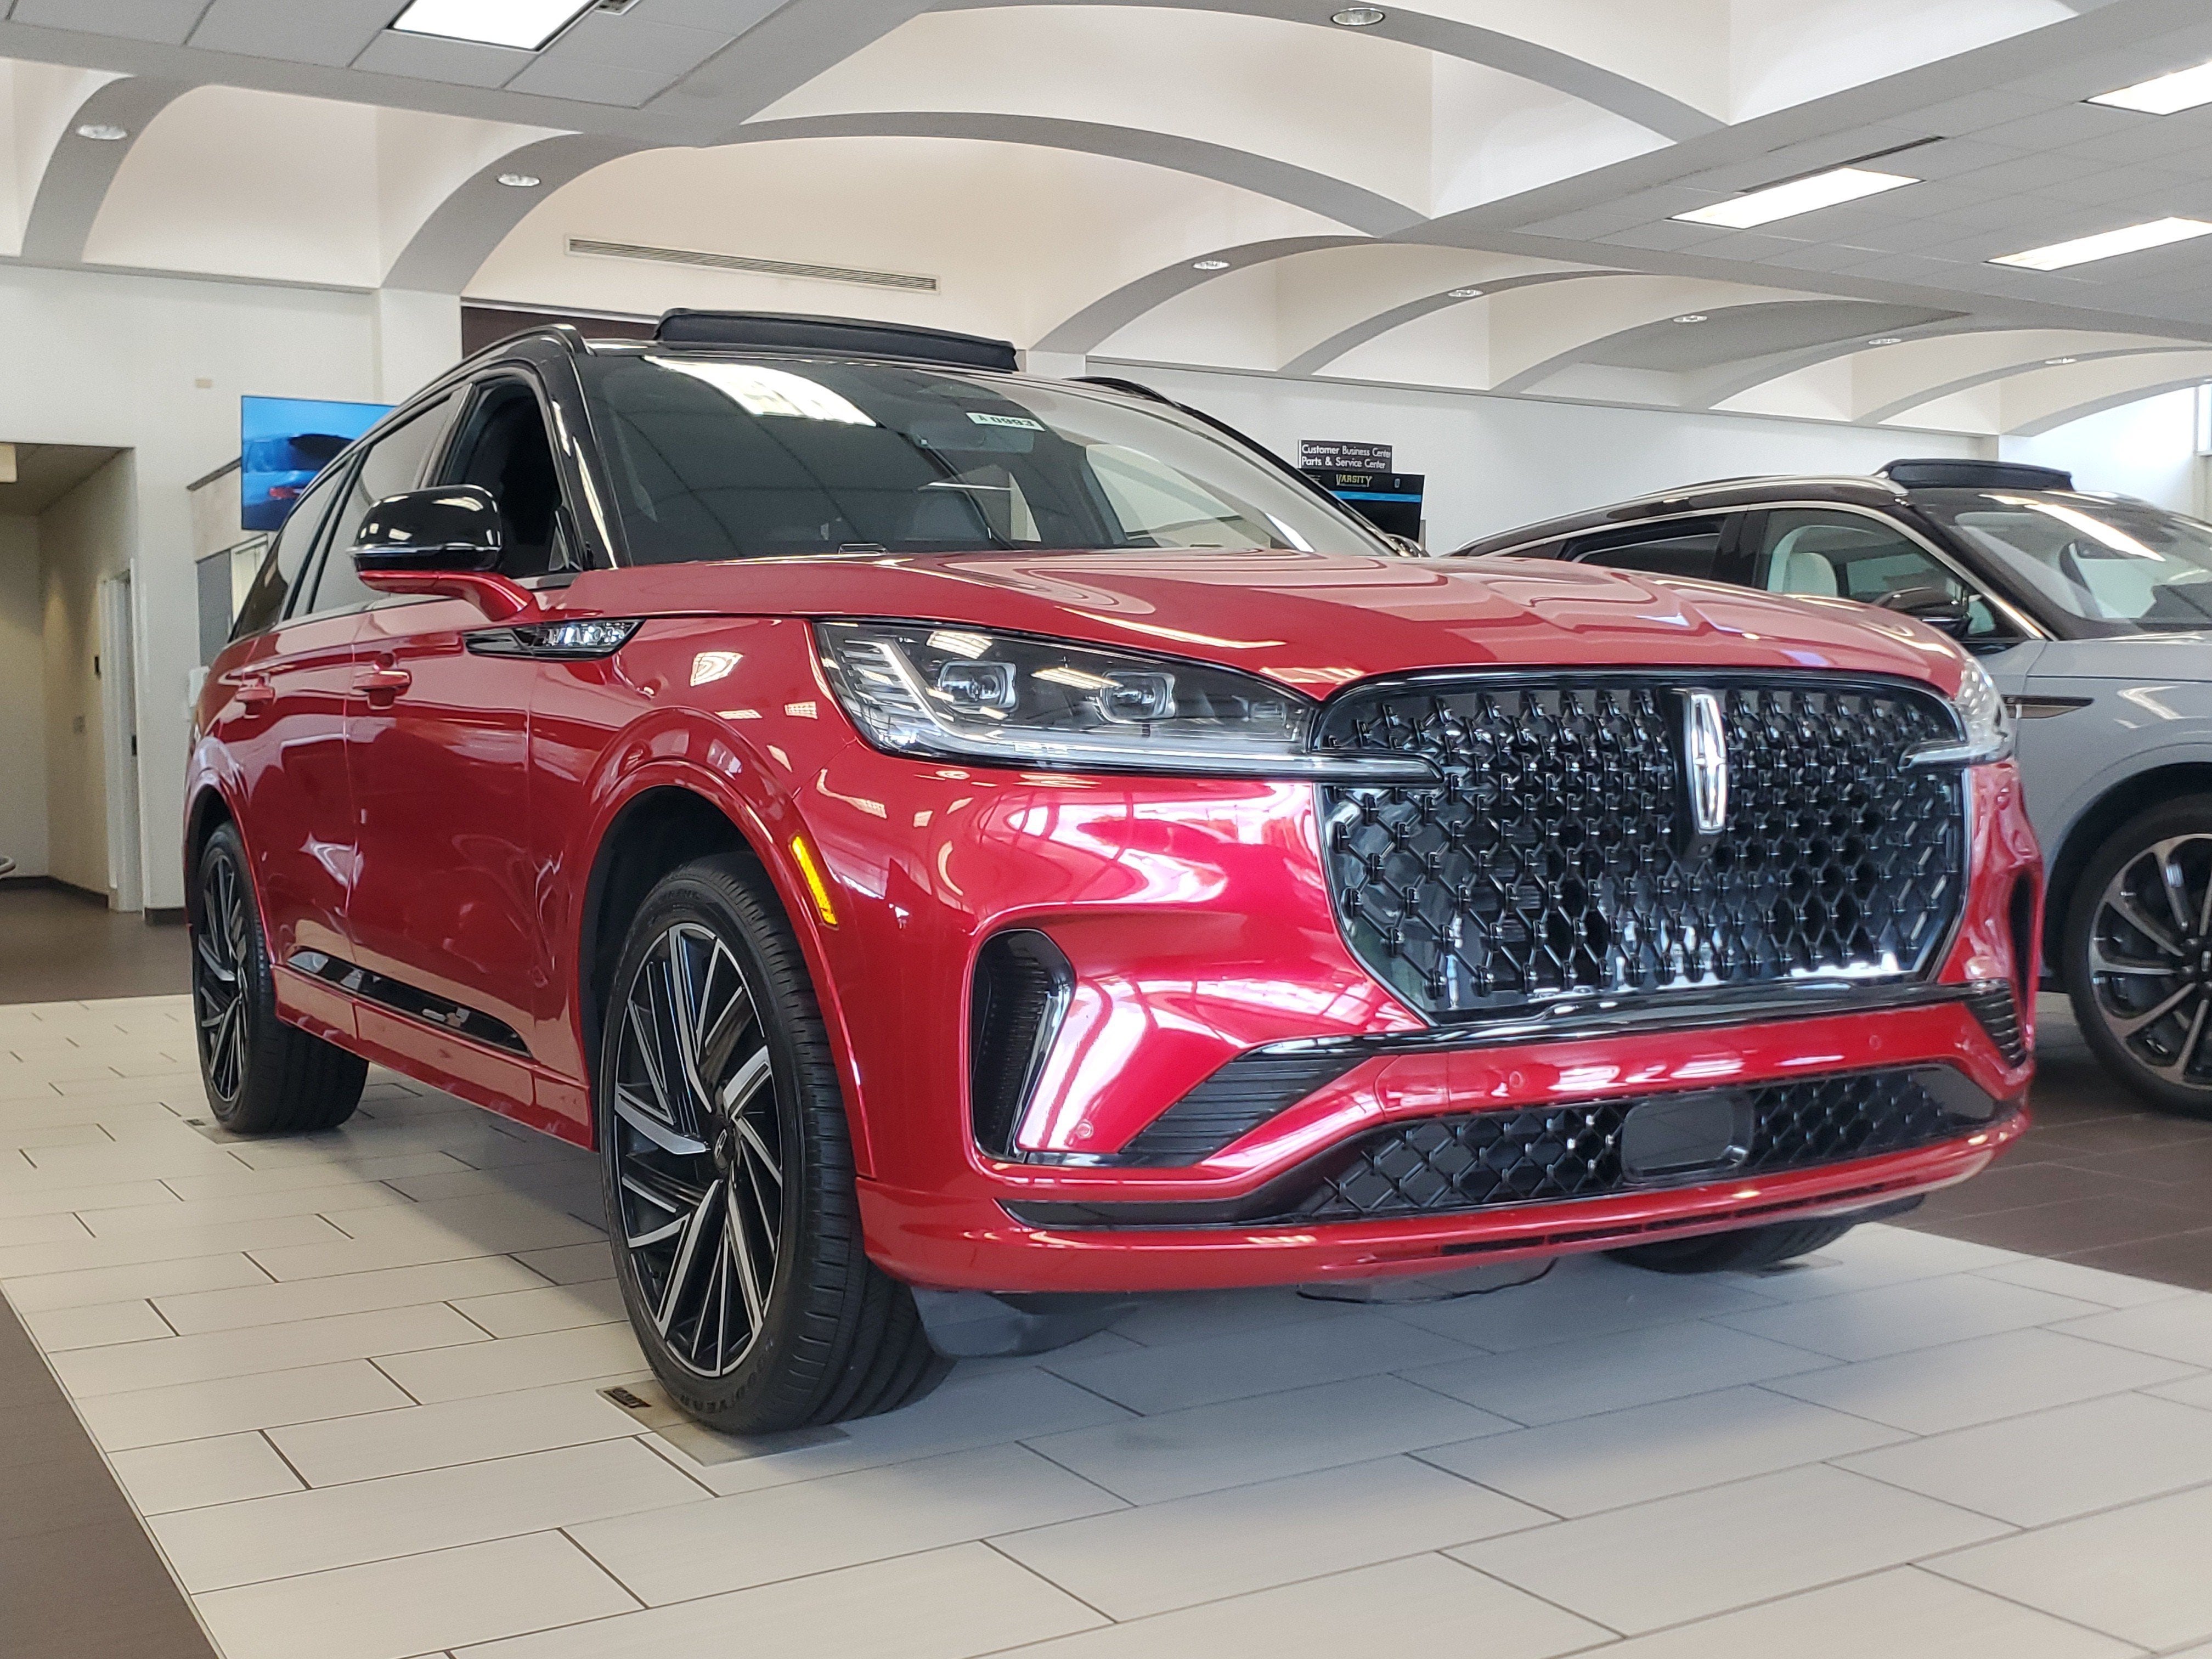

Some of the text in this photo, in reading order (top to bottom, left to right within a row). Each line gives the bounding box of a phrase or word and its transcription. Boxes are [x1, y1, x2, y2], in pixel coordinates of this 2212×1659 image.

[1302, 444, 1339, 454] Customer
[1342, 445, 1370, 456] Business
[1302, 456, 1385, 469] Parts & Service Center
[1336, 474, 1373, 487] VARSITY
